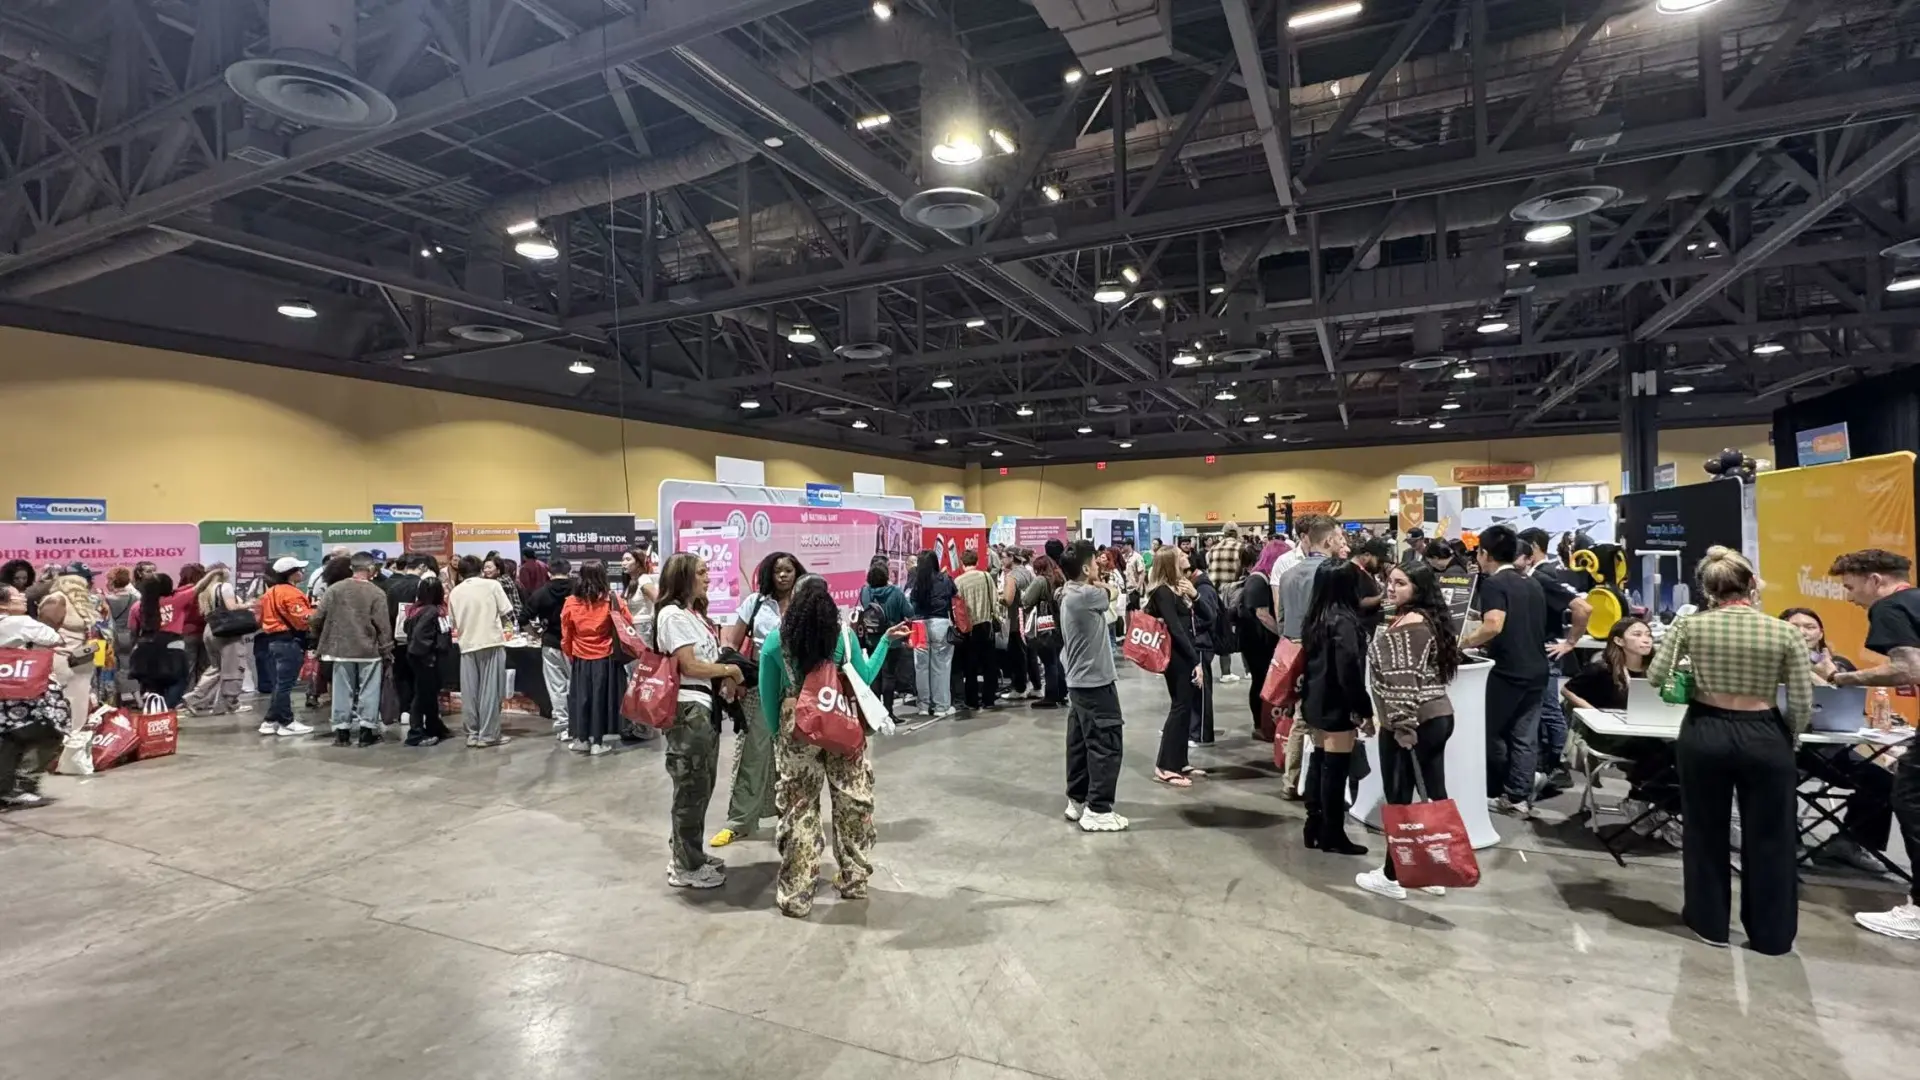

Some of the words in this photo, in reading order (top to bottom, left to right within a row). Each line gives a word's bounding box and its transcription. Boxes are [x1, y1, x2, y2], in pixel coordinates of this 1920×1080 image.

[35, 549, 75, 559] HOT
[79, 548, 119, 559] GIRL
[122, 547, 186, 557] ENERGY
[1130, 627, 1166, 650] goli
[0, 660, 36, 677] oli
[639, 663, 653, 672] Con
[92, 732, 121, 747] oli
